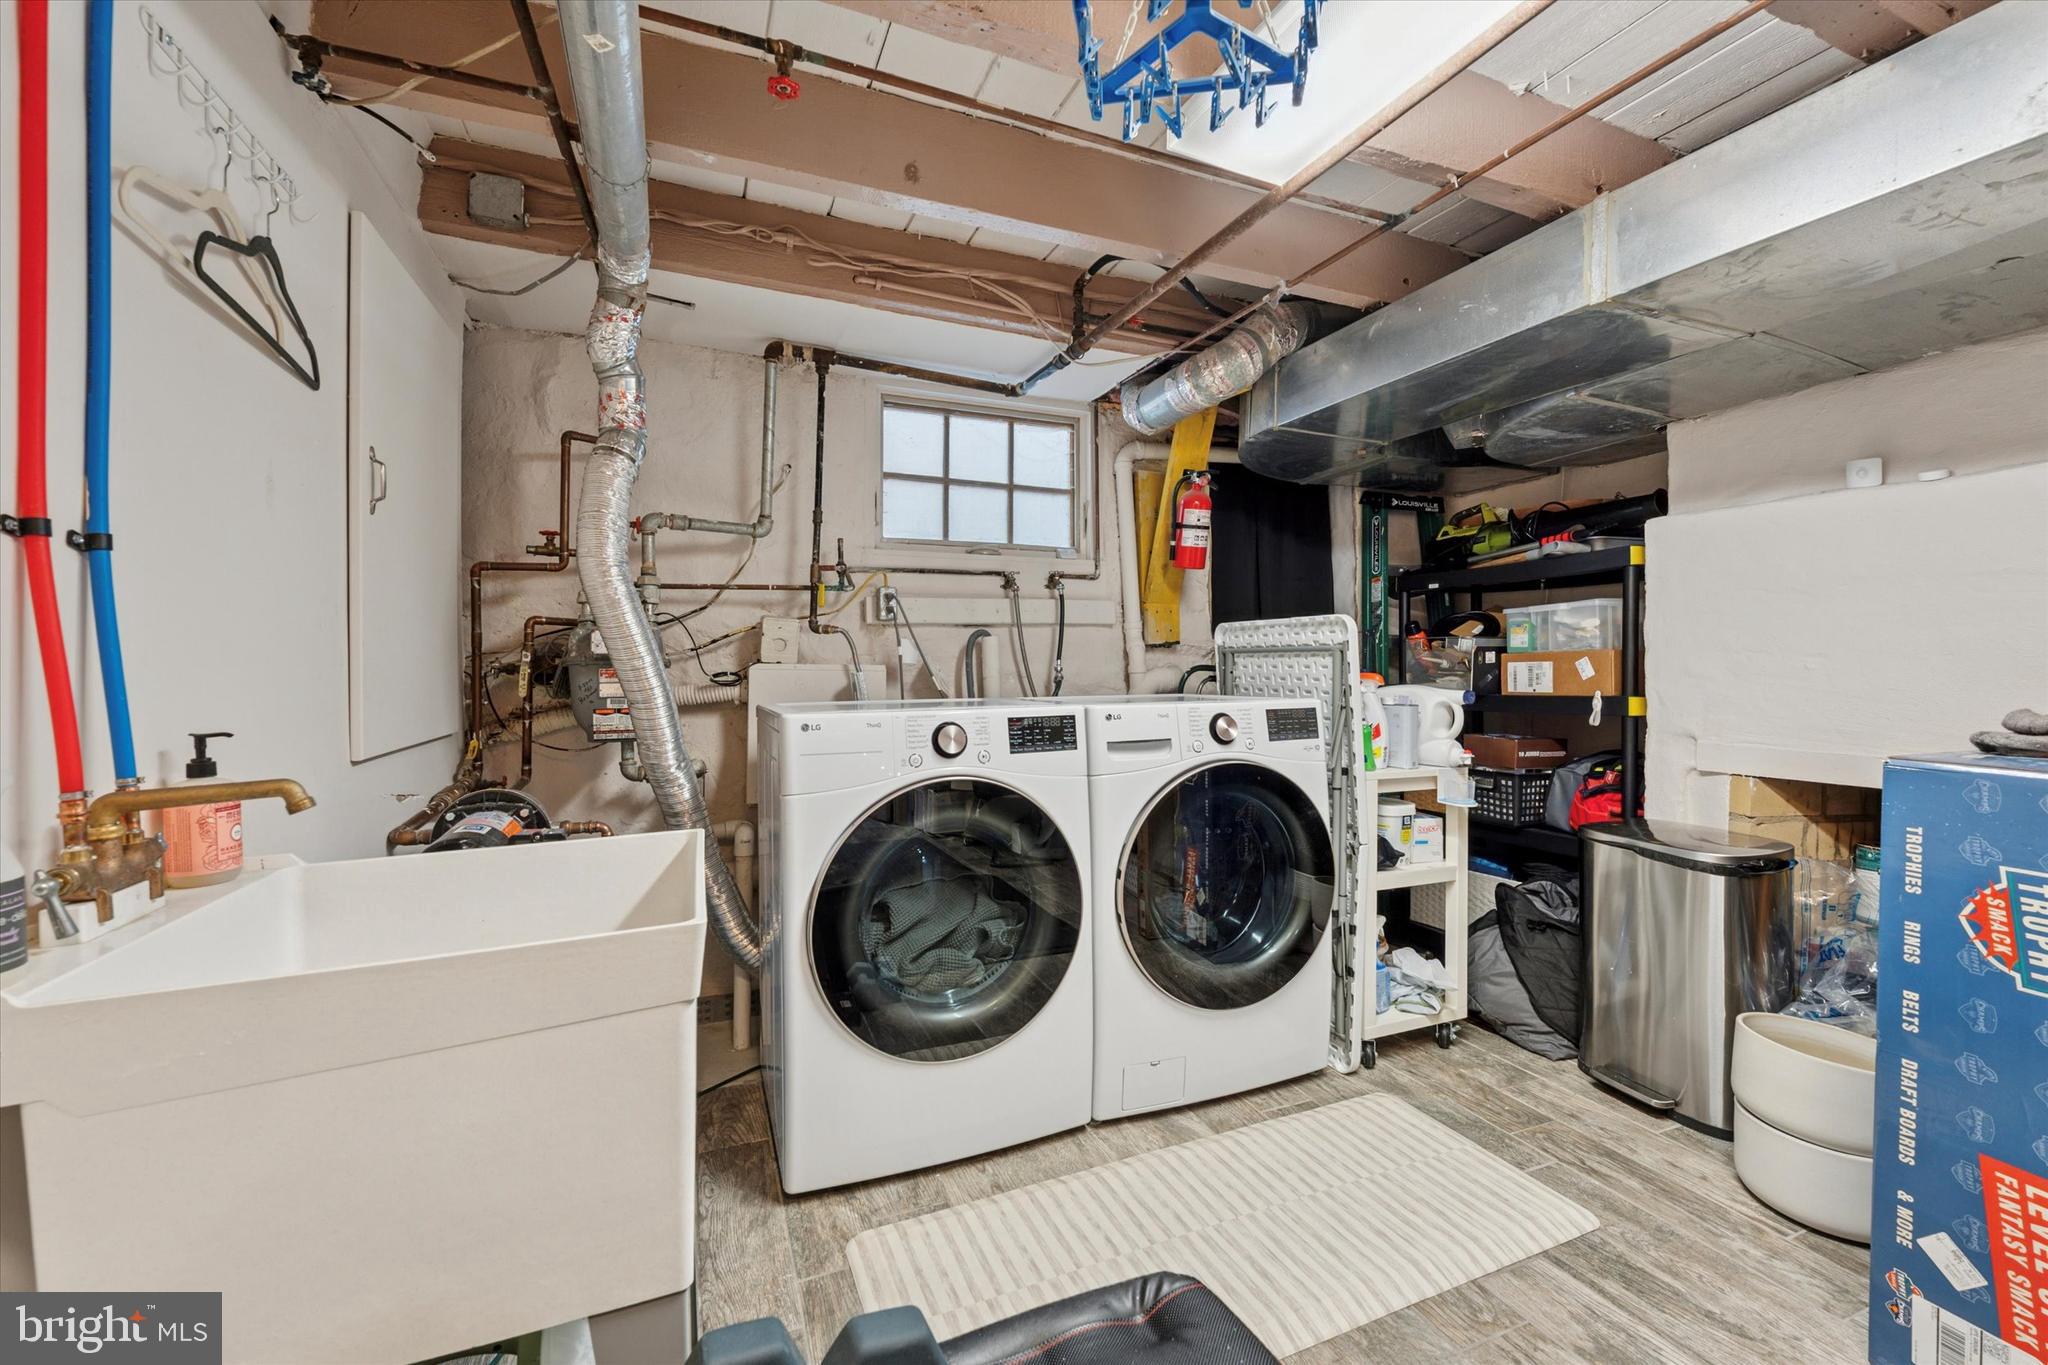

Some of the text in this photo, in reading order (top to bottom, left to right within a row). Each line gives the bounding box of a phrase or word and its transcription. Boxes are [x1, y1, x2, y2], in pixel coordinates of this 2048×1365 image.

[1399, 499, 1439, 509] LOUISVILLE
[1986, 895, 2014, 957] SMACK
[1896, 826, 1924, 1250] TROPHIES RINGS BELTS DRAFT BOARDS & MORE
[1994, 1170, 2040, 1351] FANTASY SMACK
